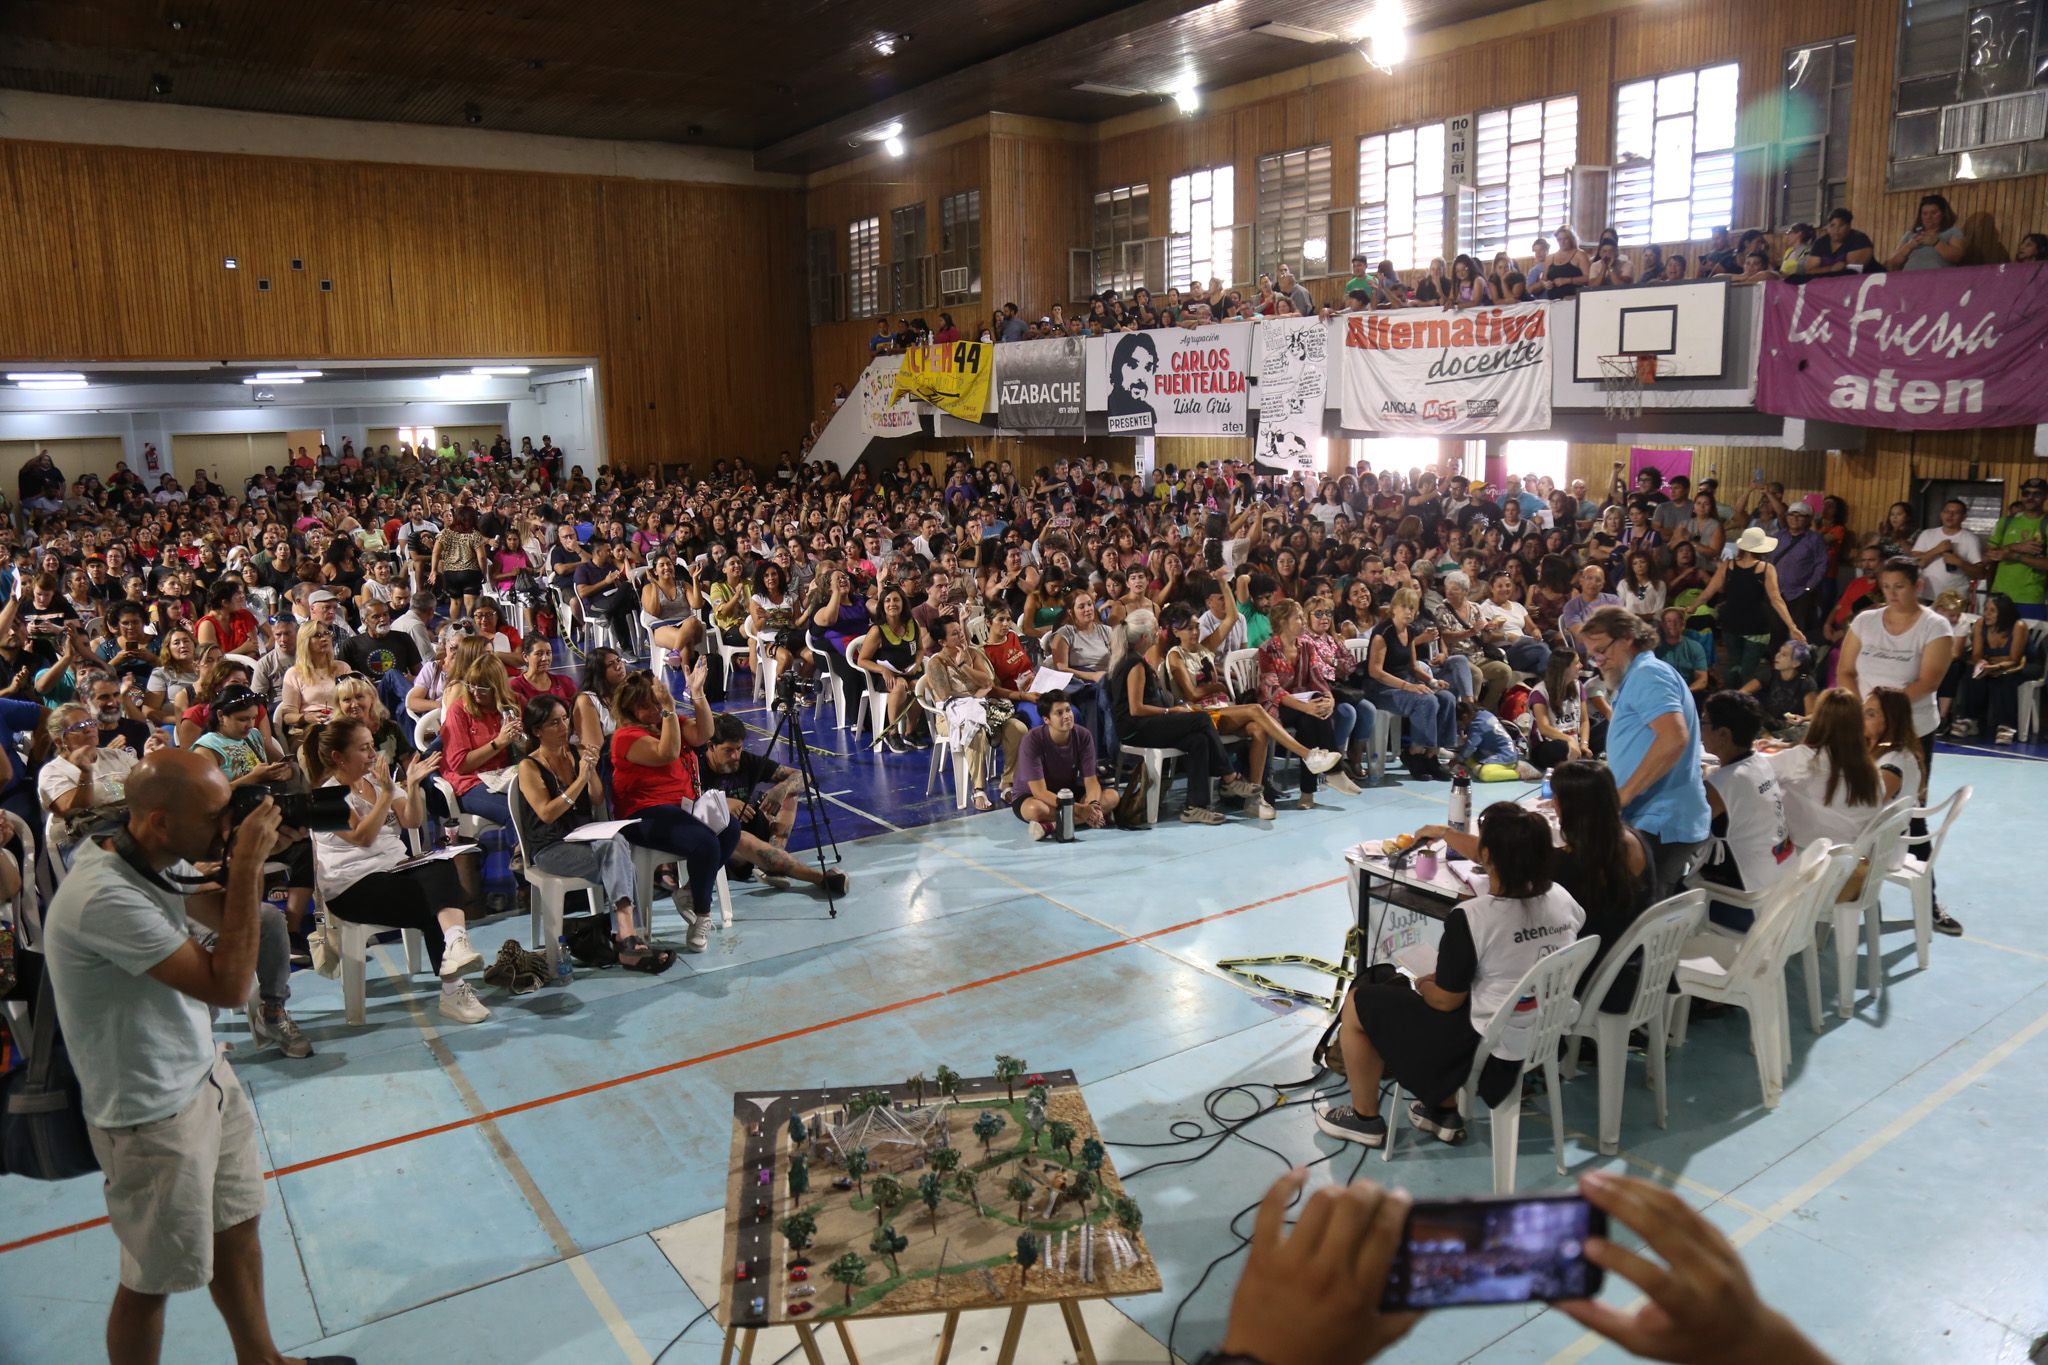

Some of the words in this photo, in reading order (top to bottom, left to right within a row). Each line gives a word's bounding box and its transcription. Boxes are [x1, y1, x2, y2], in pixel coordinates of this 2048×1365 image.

[1788, 284, 1833, 345] La
[1345, 308, 1545, 350] Alternativa
[1171, 347, 1231, 371] CARLOS
[1428, 339, 1544, 379] docente
[1000, 382, 1081, 405] AZABACHE
[1154, 370, 1246, 396] FUENTEALBA
[1829, 368, 1985, 415] aten
[1173, 398, 1202, 415] Lista
[1109, 414, 1150, 430] PRESENTE!
[1514, 926, 1548, 943] aten
